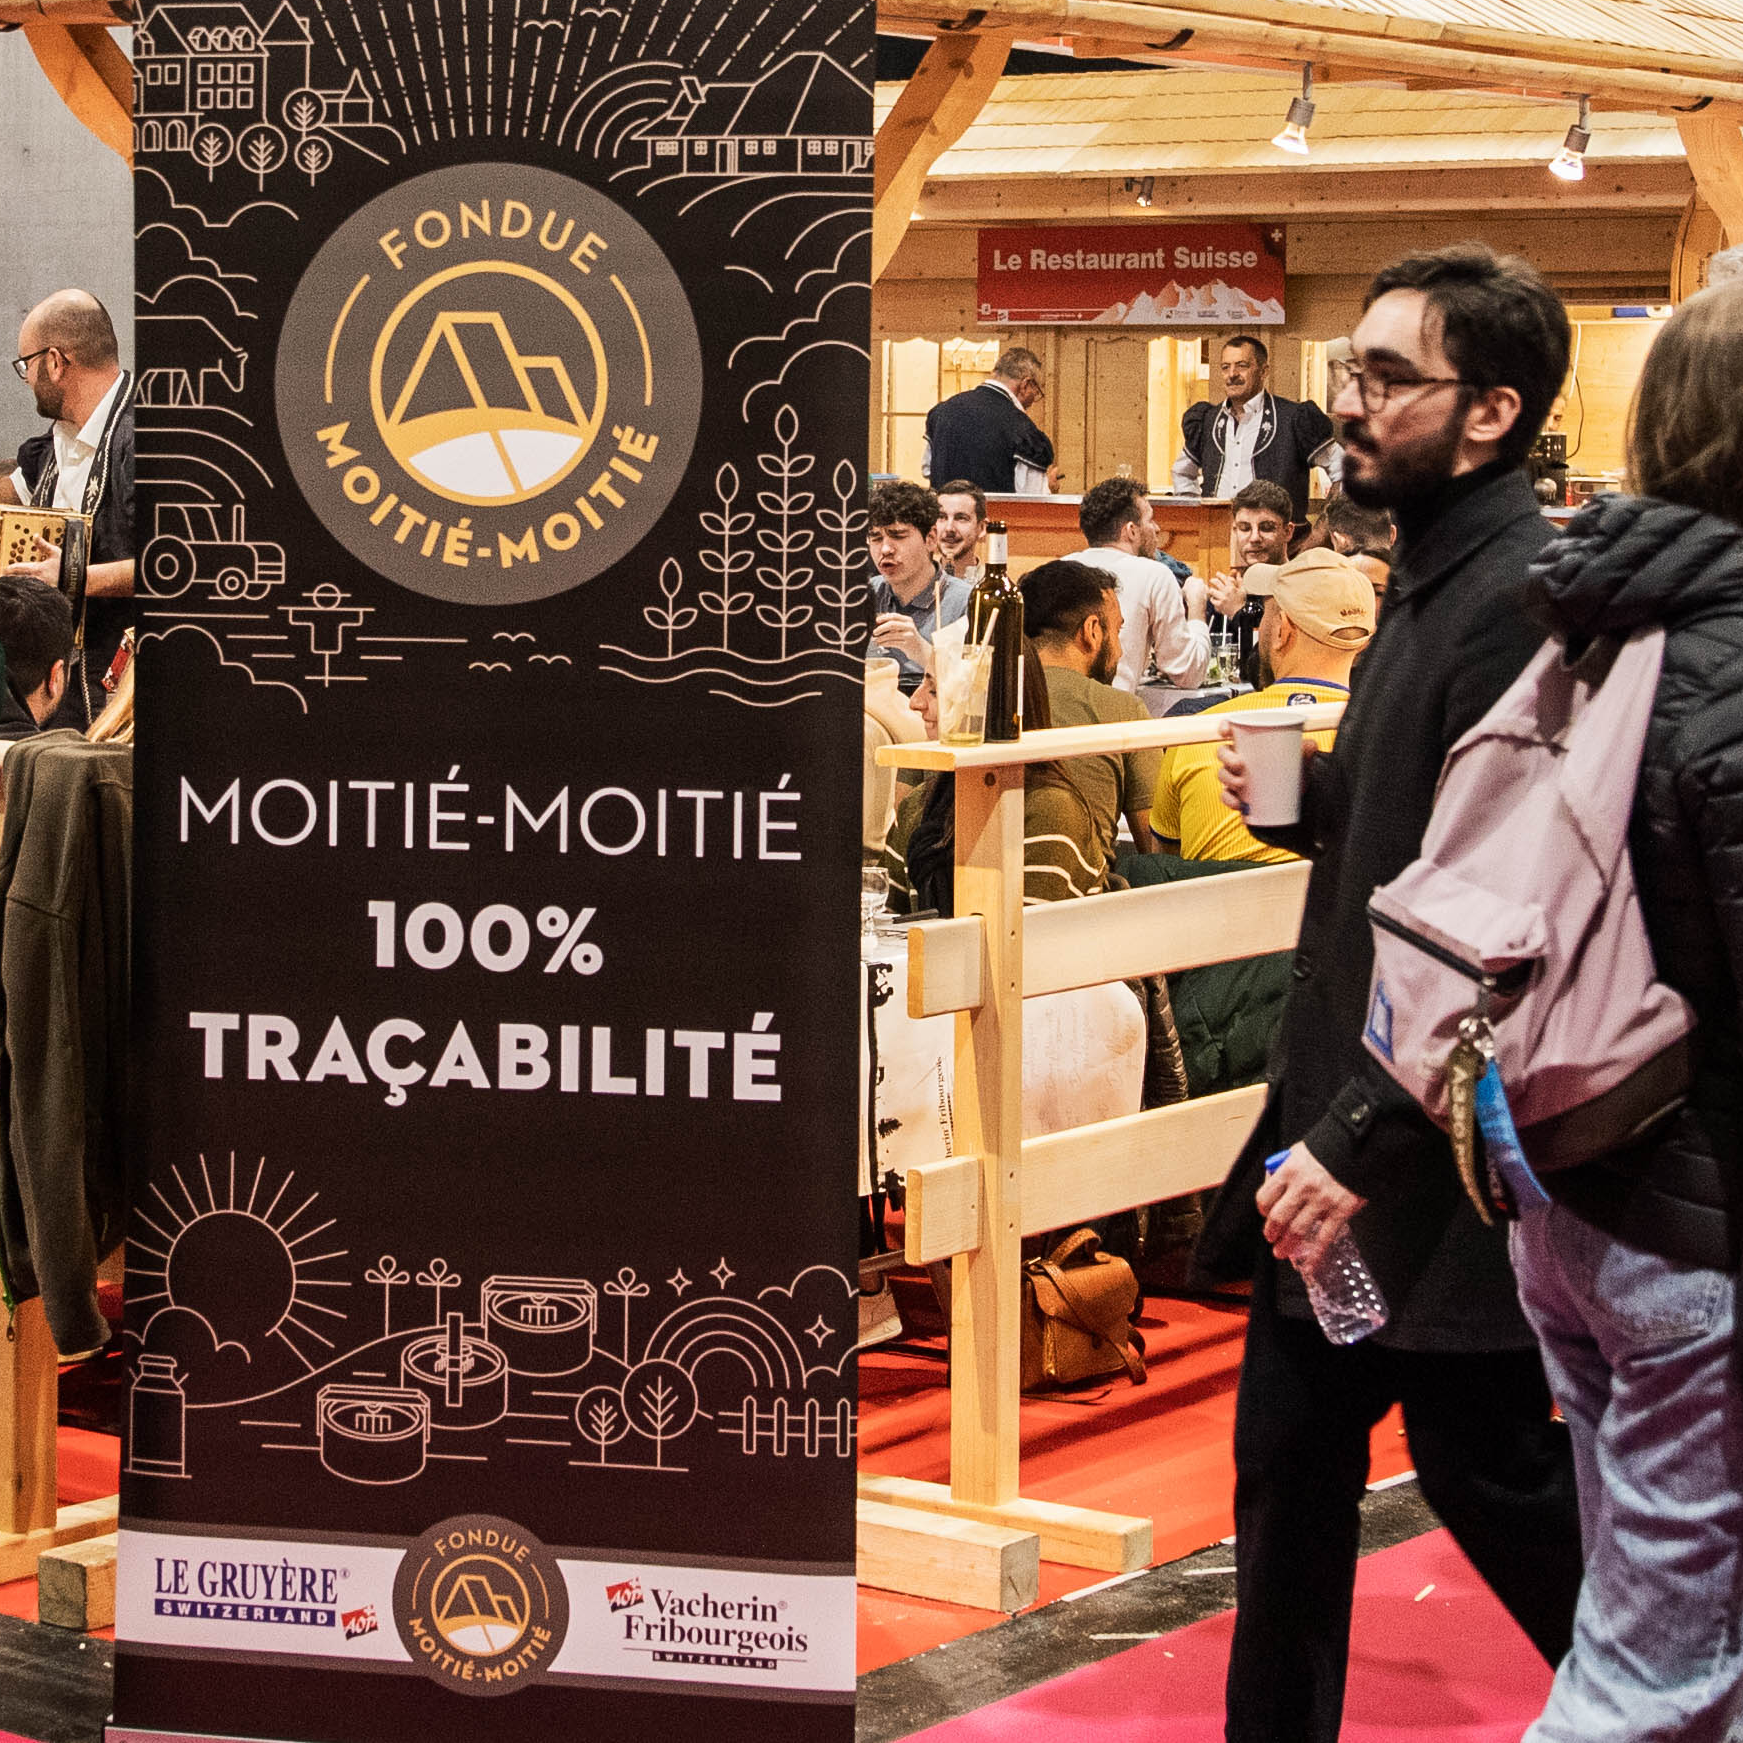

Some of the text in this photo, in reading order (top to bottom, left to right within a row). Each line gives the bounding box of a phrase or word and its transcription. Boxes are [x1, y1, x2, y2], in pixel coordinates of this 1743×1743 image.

[378, 199, 609, 275] FONDUE
[993, 246, 1258, 270] Le Restaurant Suisse
[316, 422, 661, 569] MOITIÉ-MOITIÉ
[179, 765, 803, 861] MOITIÉ-MOITIÉ
[367, 899, 604, 976] 100%
[188, 1011, 782, 1106] TRAÇABILITÉ
[938, 1057, 949, 1126] Fribourgeois
[433, 1529, 532, 1563] FONDUE
[155, 1558, 339, 1605] LE GRUYÈRE
[608, 1584, 644, 1609] AOP
[161, 1601, 331, 1625] SWITZERLAND
[343, 1615, 378, 1638] AOP
[651, 1586, 778, 1623] Vacherin
[408, 1616, 553, 1683] MOITIÉ-MOITIÉ
[623, 1613, 809, 1655] Fribourgeois
[653, 1652, 776, 1670] SWITZERLAND
